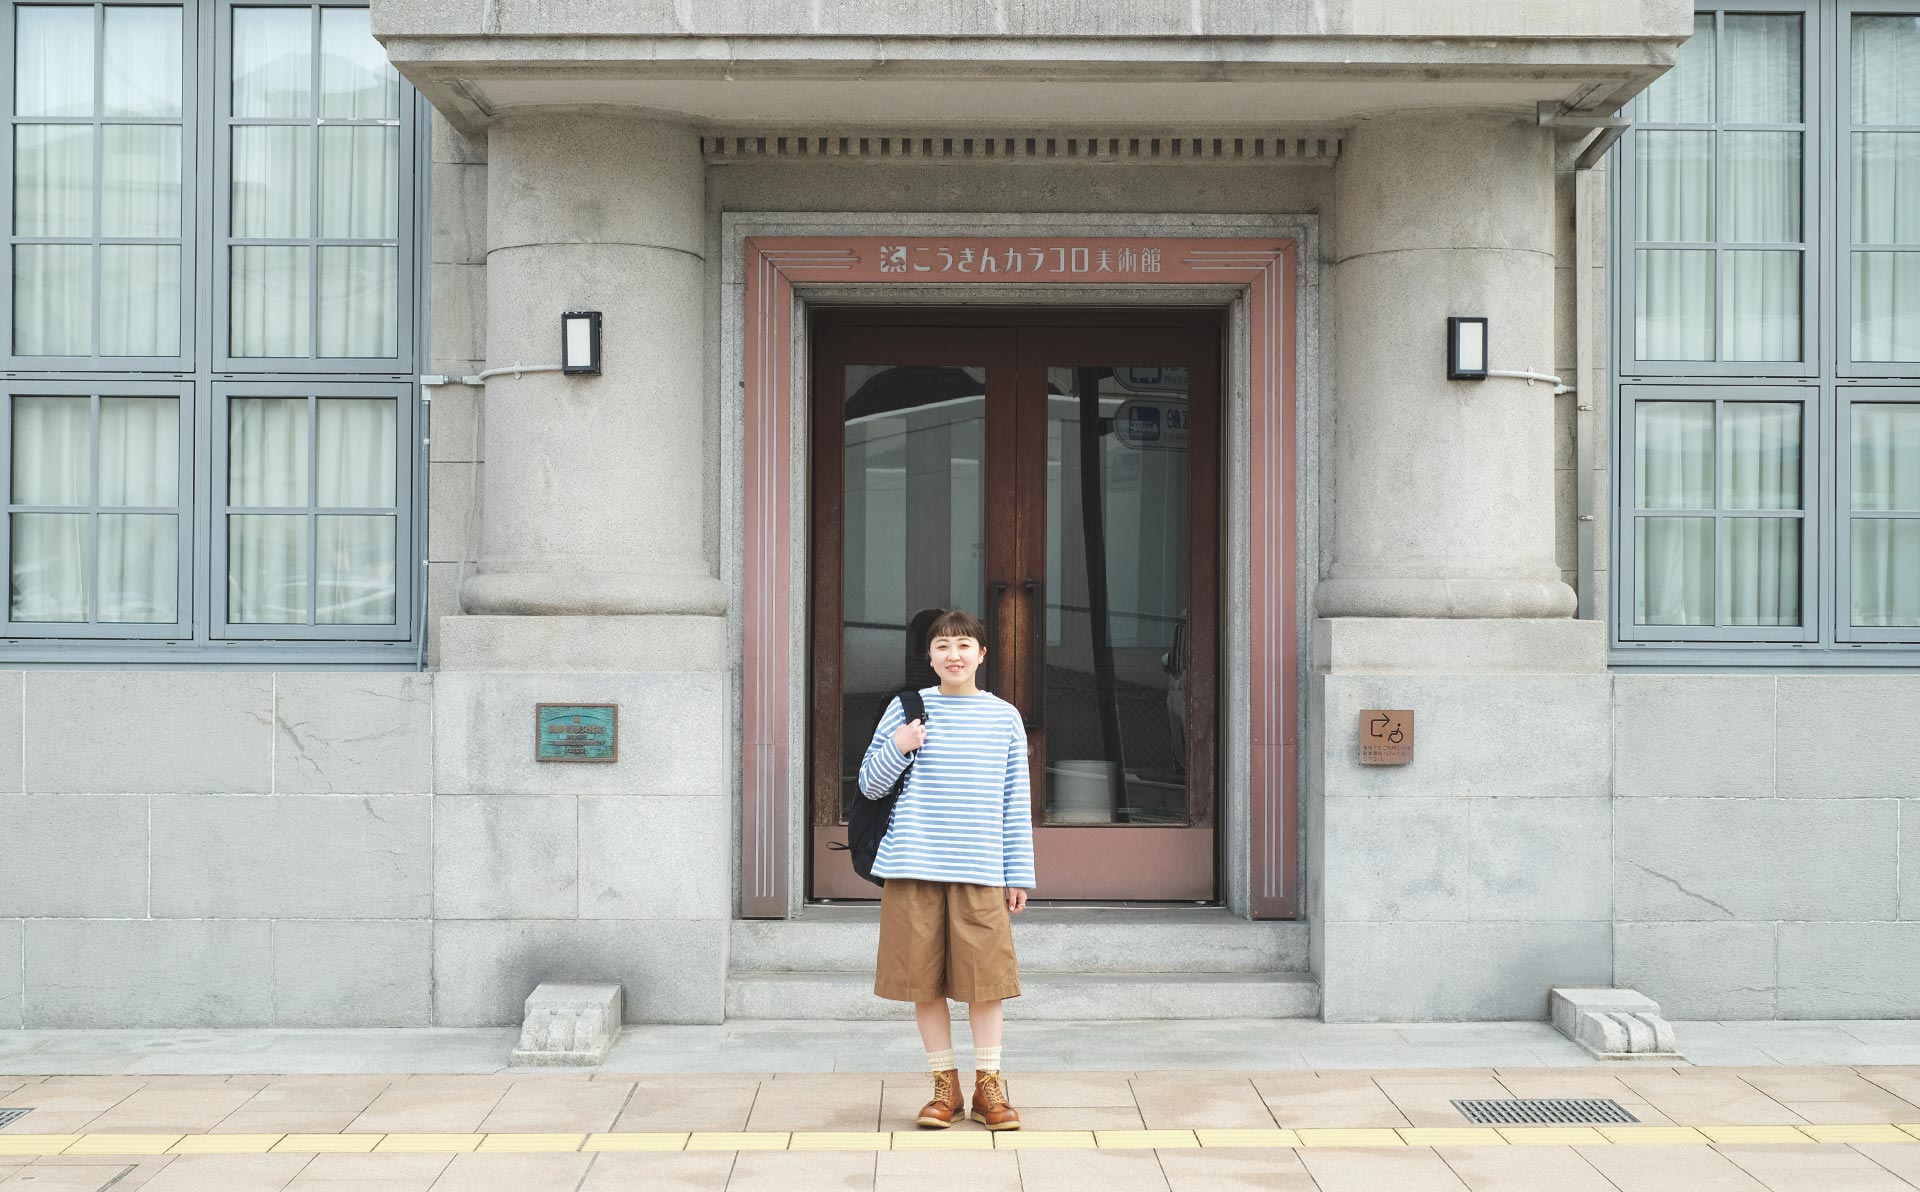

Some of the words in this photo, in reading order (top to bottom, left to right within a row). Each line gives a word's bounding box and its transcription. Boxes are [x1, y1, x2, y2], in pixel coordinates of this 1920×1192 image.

[913, 247, 1160, 273] こうぎんカラコロ美術館
